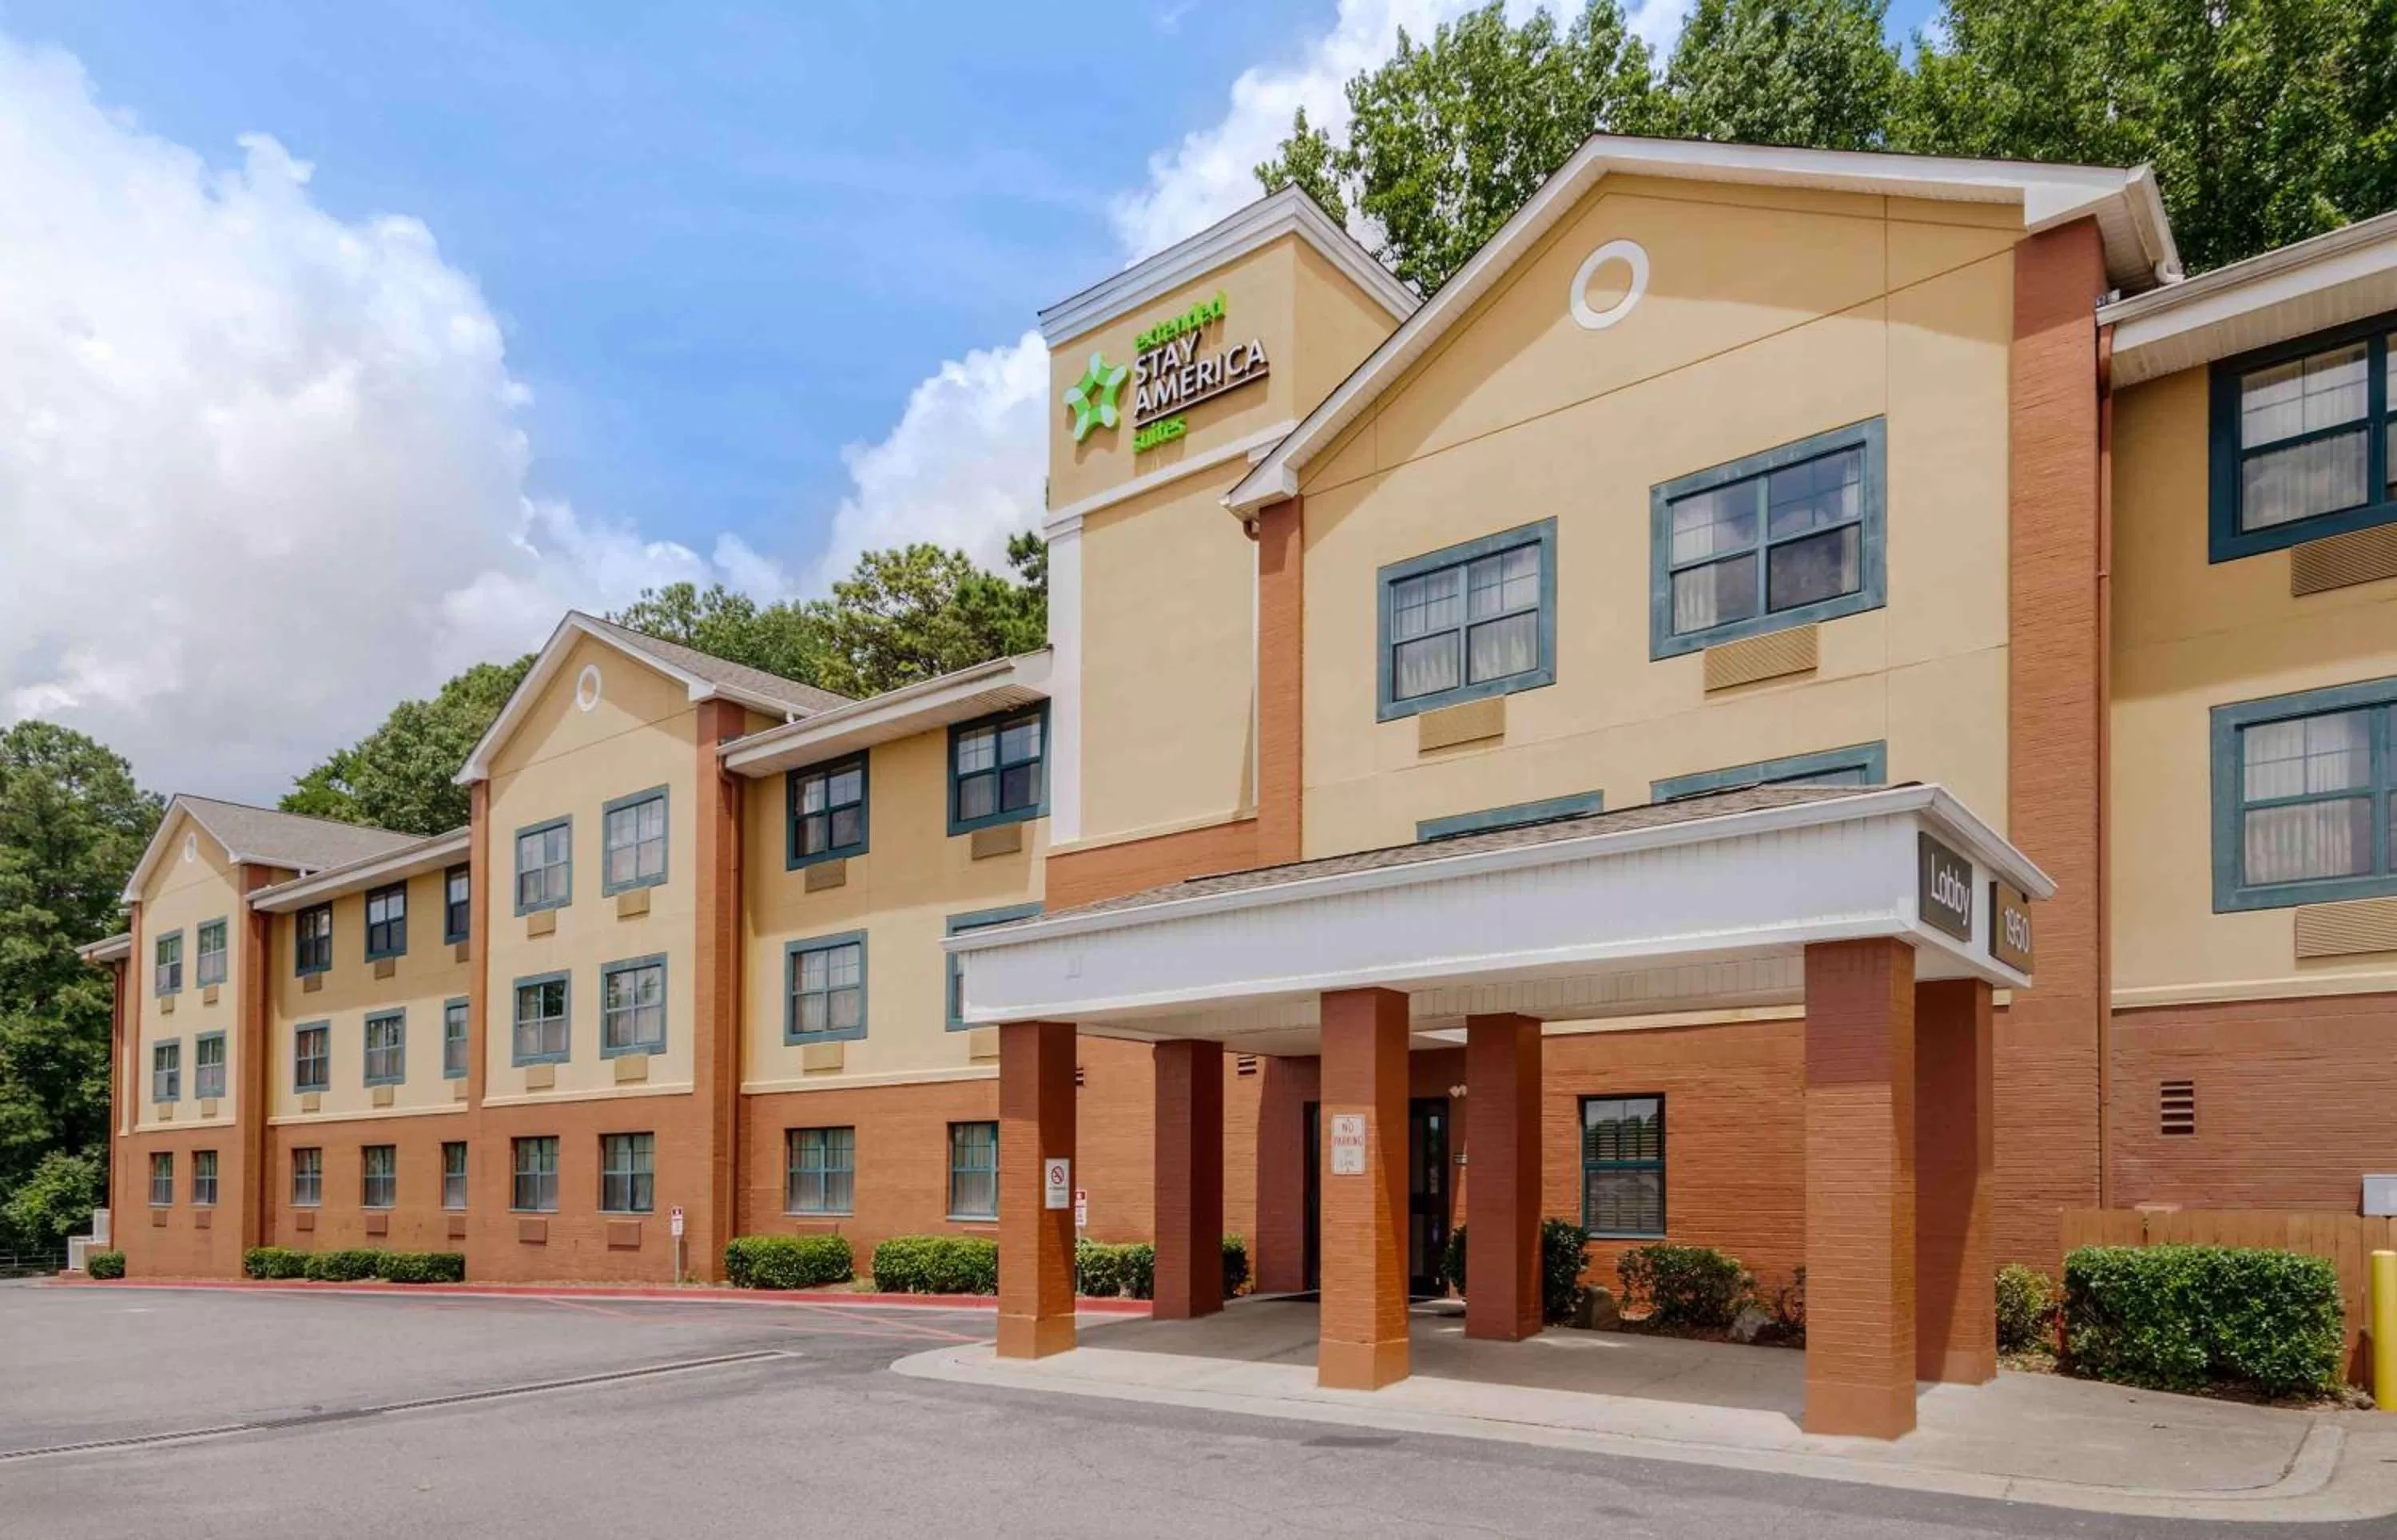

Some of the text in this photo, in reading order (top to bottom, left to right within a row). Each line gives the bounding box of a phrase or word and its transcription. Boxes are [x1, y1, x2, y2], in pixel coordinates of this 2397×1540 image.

[1135, 331, 1201, 385] STAY
[1135, 337, 1268, 416] AMERICA
[1931, 852, 1970, 927] Lobby
[2005, 906, 2030, 953] 1950
[1342, 1122, 1354, 1133] NO
